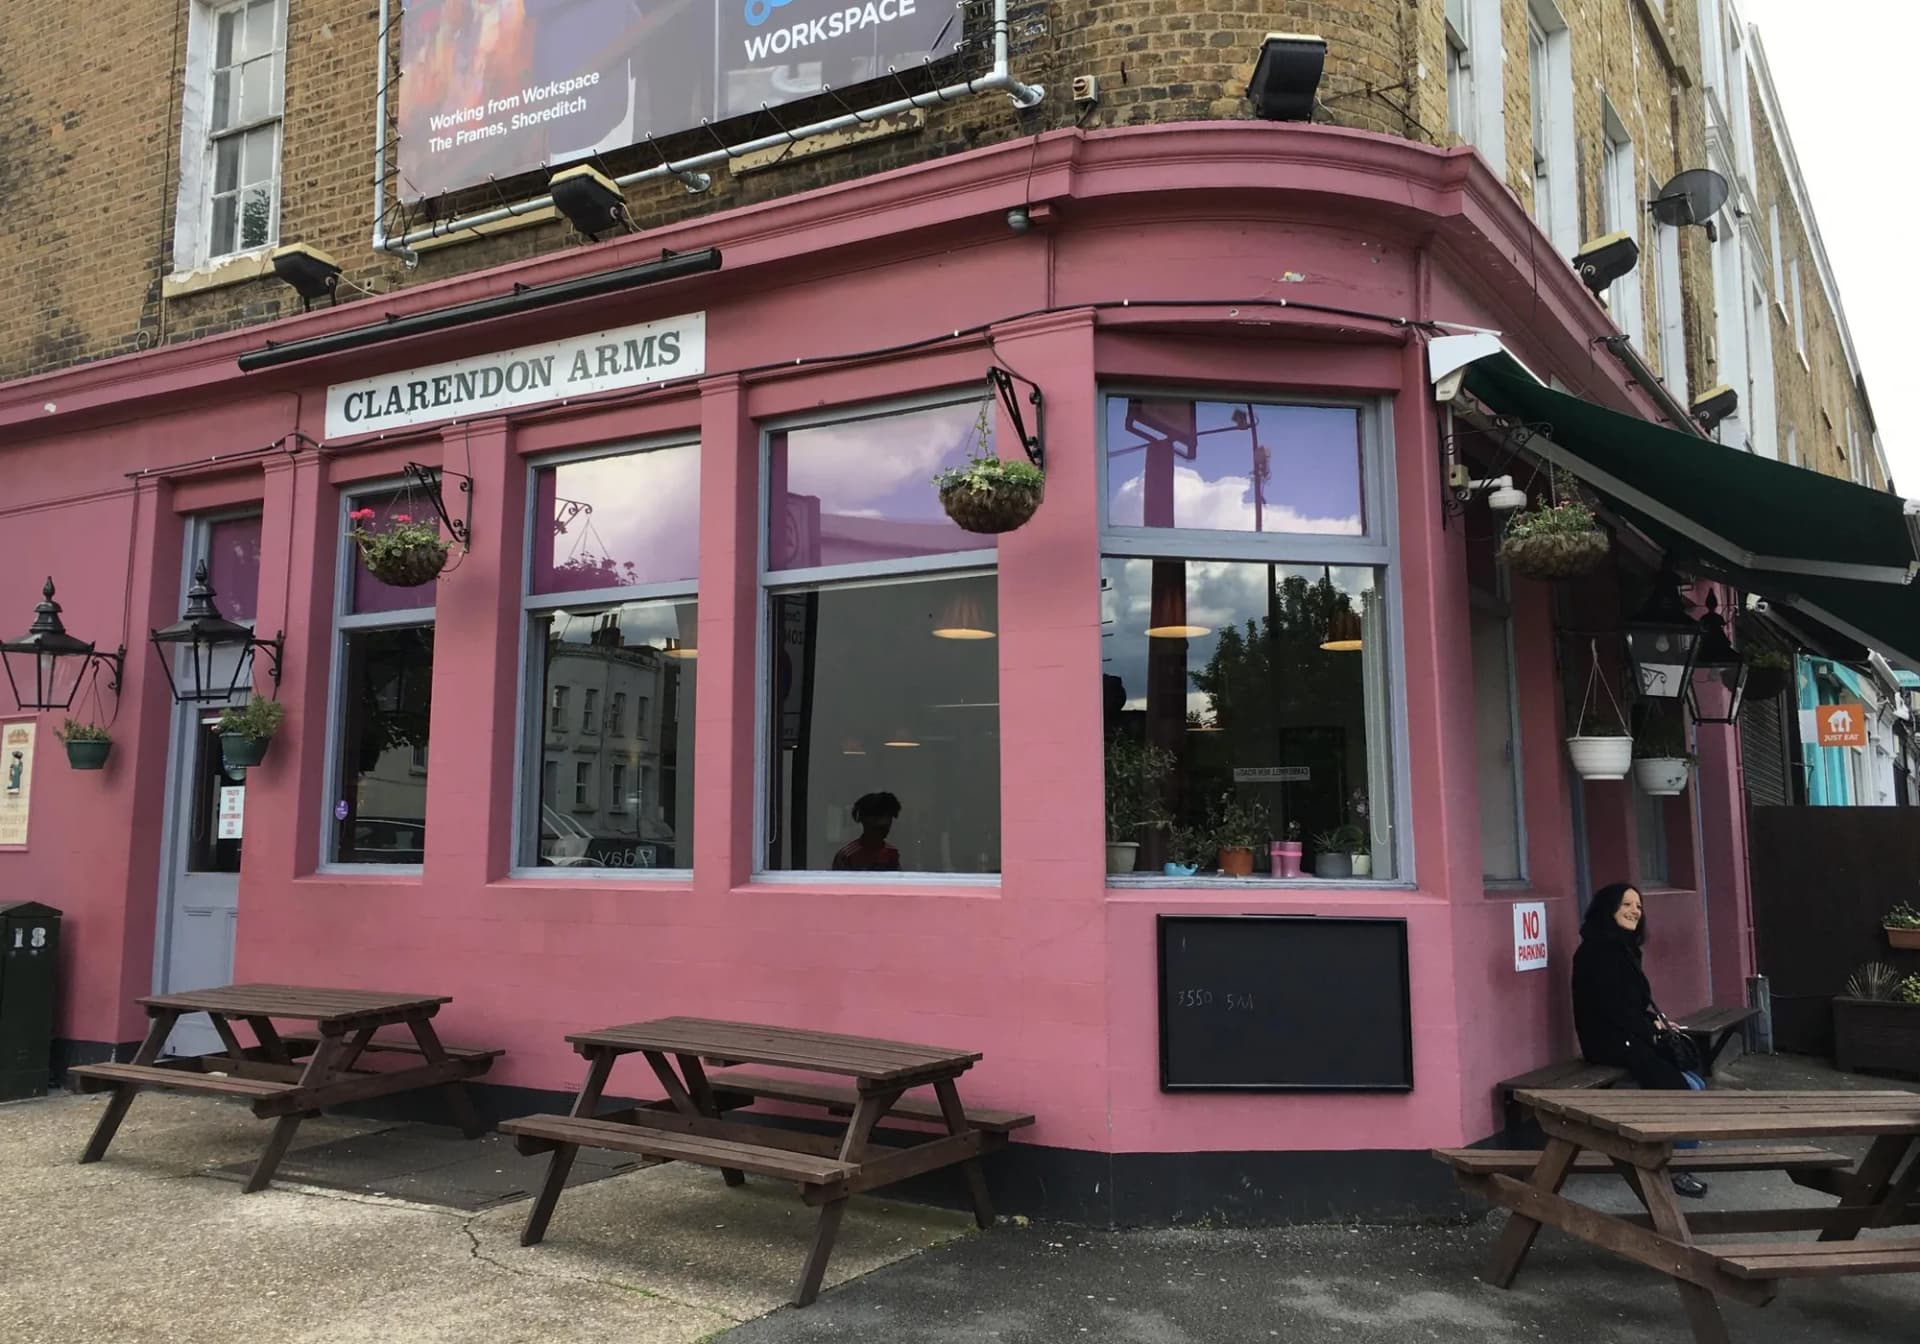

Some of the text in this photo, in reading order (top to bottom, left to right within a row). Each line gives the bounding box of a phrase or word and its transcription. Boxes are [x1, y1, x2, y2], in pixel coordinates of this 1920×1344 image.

[744, 0, 917, 62] WORKSPACE
[428, 96, 587, 153] The Frames, Shoreditch
[429, 71, 600, 131] Working from Workspace
[343, 330, 682, 423] CLARENDON ARMS
[1824, 733, 1860, 742] JUST EAT
[1518, 910, 1545, 961] NO PARKING
